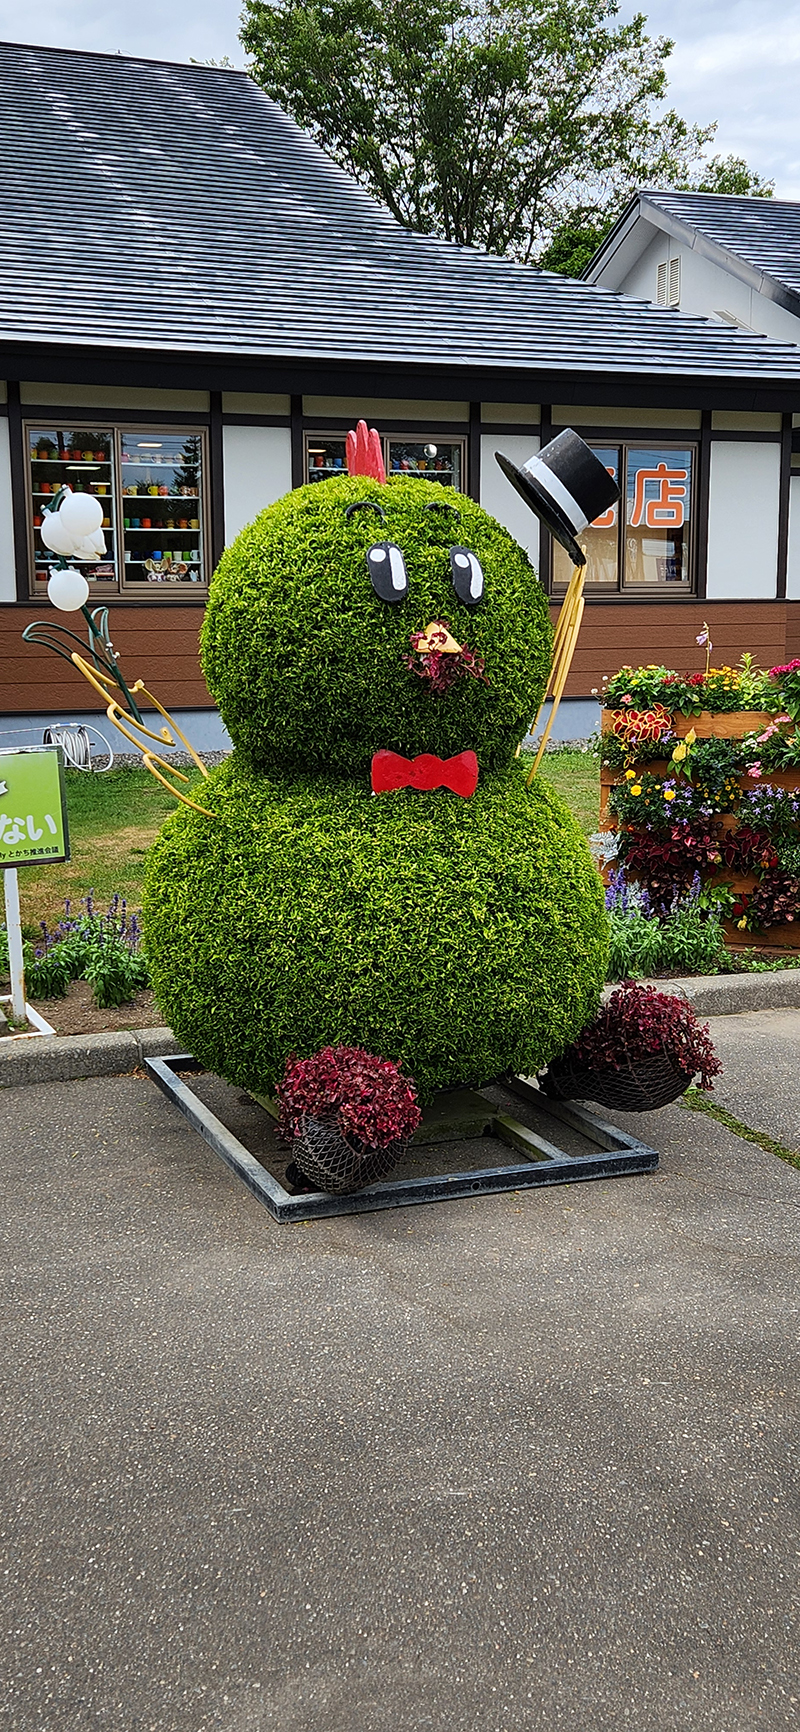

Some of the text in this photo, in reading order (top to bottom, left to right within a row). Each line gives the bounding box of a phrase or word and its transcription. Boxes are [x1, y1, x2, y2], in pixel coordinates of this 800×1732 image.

[589, 462, 688, 529] 店
[0, 814, 57, 845] ない
[9, 846, 59, 857] とかち推進会議
